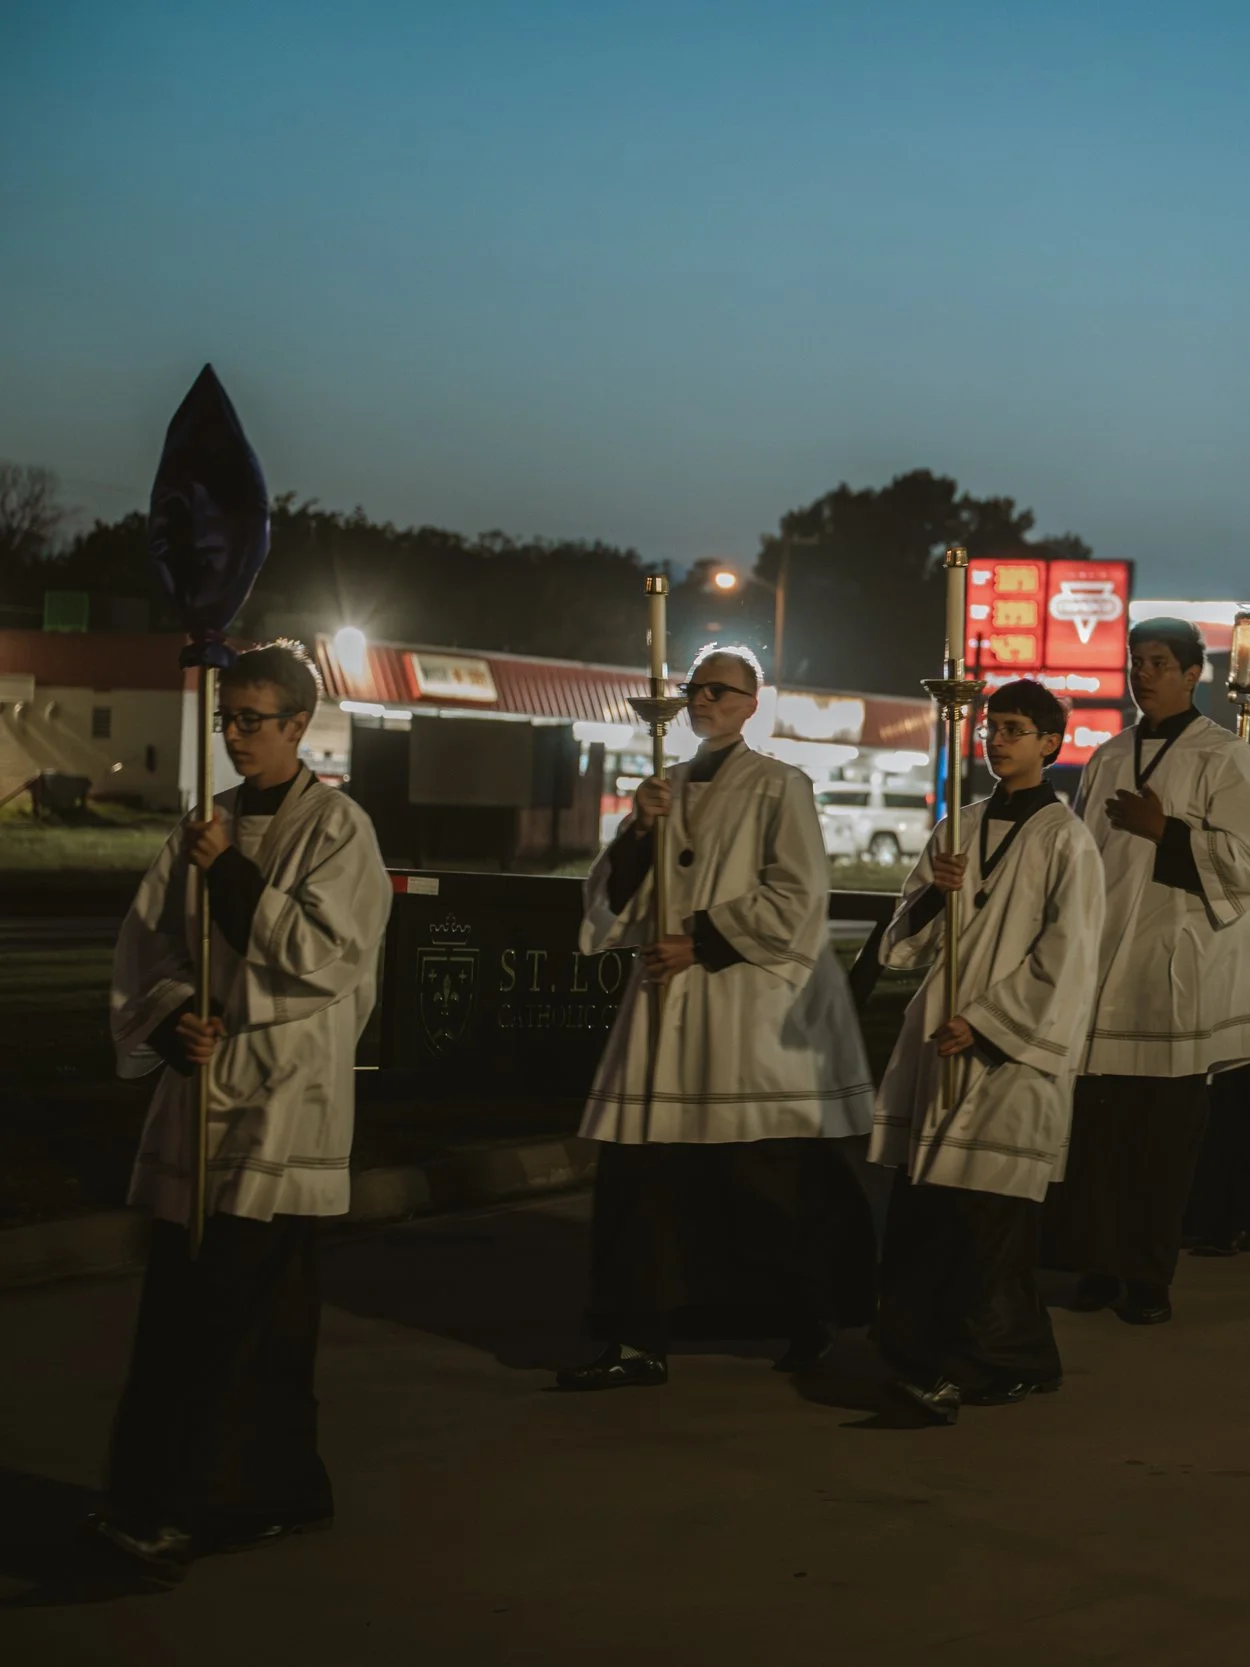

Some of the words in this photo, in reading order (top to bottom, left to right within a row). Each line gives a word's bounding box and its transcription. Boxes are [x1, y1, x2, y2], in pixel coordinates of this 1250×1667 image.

[499, 948, 556, 993] ST.
[570, 950, 634, 994] LO
[498, 1003, 597, 1029] CATHOLIC
